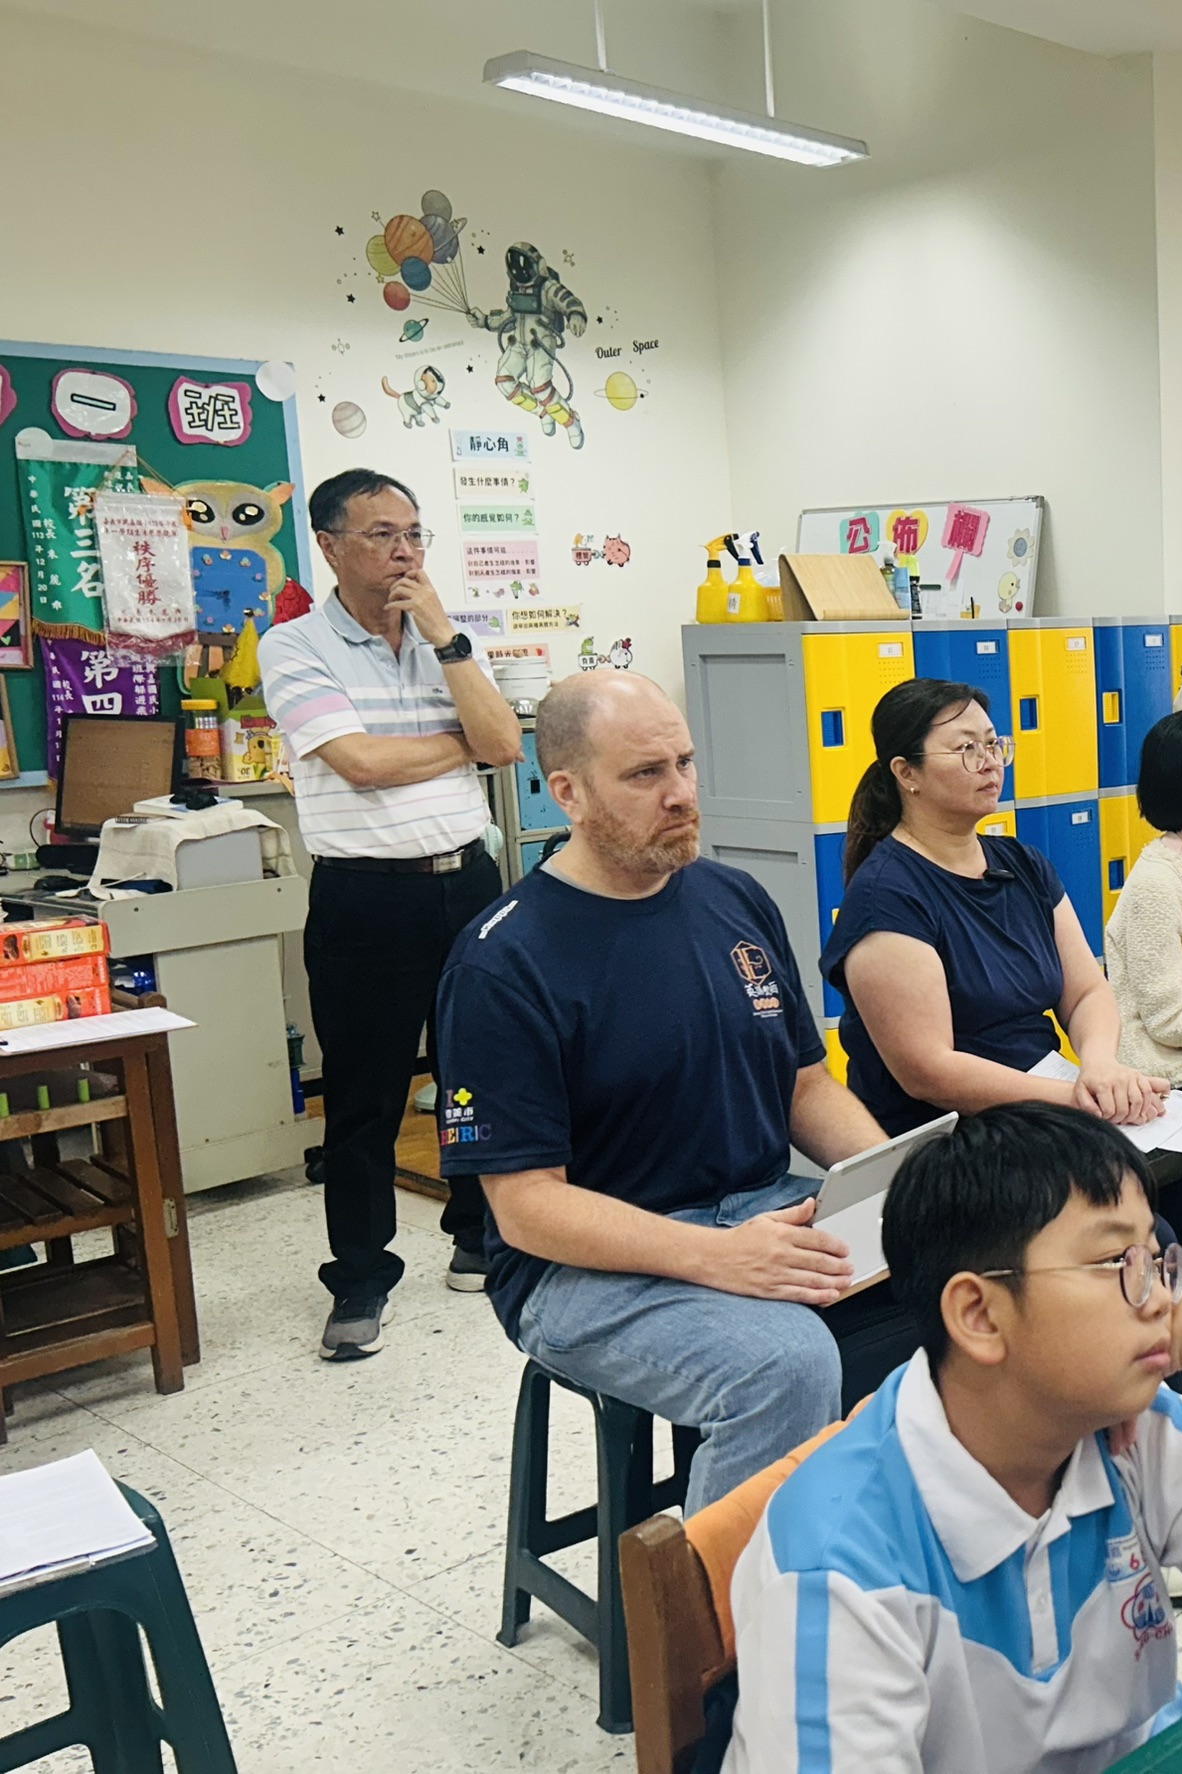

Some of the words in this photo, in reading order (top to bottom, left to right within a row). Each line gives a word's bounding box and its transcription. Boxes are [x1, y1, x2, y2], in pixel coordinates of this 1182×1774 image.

[595, 346, 622, 360] Outer
[632, 338, 660, 354] Space
[469, 435, 509, 452] 靜心角
[460, 476, 515, 486] 發生什麼事情？
[463, 513, 519, 523] 你的感覺如何？
[132, 540, 162, 606] 秩序優勝
[512, 608, 567, 620] 你想如何解決？
